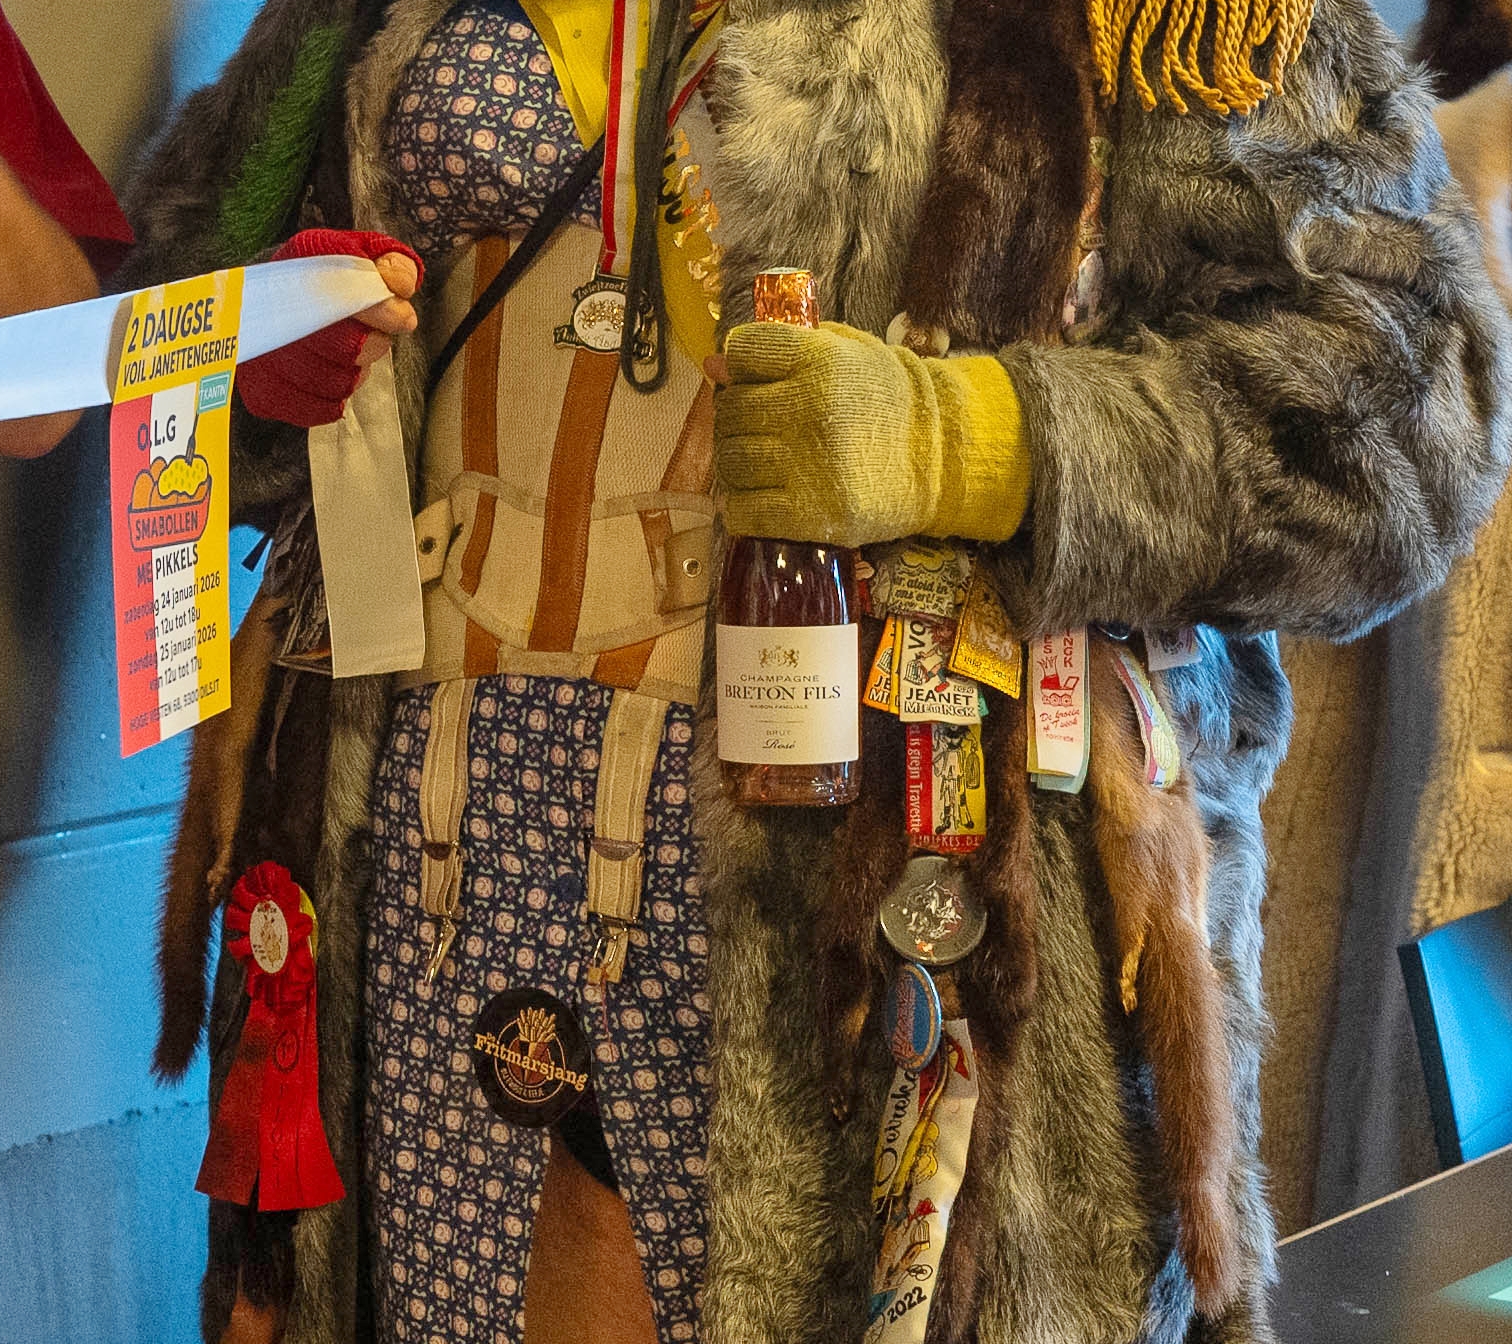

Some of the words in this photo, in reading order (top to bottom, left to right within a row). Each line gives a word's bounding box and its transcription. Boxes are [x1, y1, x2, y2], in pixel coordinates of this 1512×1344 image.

[127, 316, 140, 354] 2
[141, 297, 215, 349] DAUGSE
[123, 361, 147, 387] VOIL
[149, 335, 238, 381] JANETTENGERIEF
[137, 413, 177, 452] O.L.G
[135, 510, 198, 542] SMABOLLEN
[155, 543, 199, 581] PIKKELS
[160, 590, 171, 609] 24
[171, 577, 199, 609] januari
[200, 570, 221, 594] 2026
[160, 617, 174, 637] 12u
[175, 612, 188, 631] tot
[160, 642, 170, 662] 25
[170, 630, 197, 662] januari
[197, 622, 218, 646] 2026
[164, 667, 178, 686] 12u
[177, 661, 190, 680] tot
[739, 674, 821, 683] CHAMPAGNE
[725, 684, 796, 702] BRETON
[803, 684, 842, 701] FILS
[905, 686, 974, 707] JEANET
[473, 1032, 590, 1093] Fritmarsjang
[886, 1285, 928, 1324] 2022
